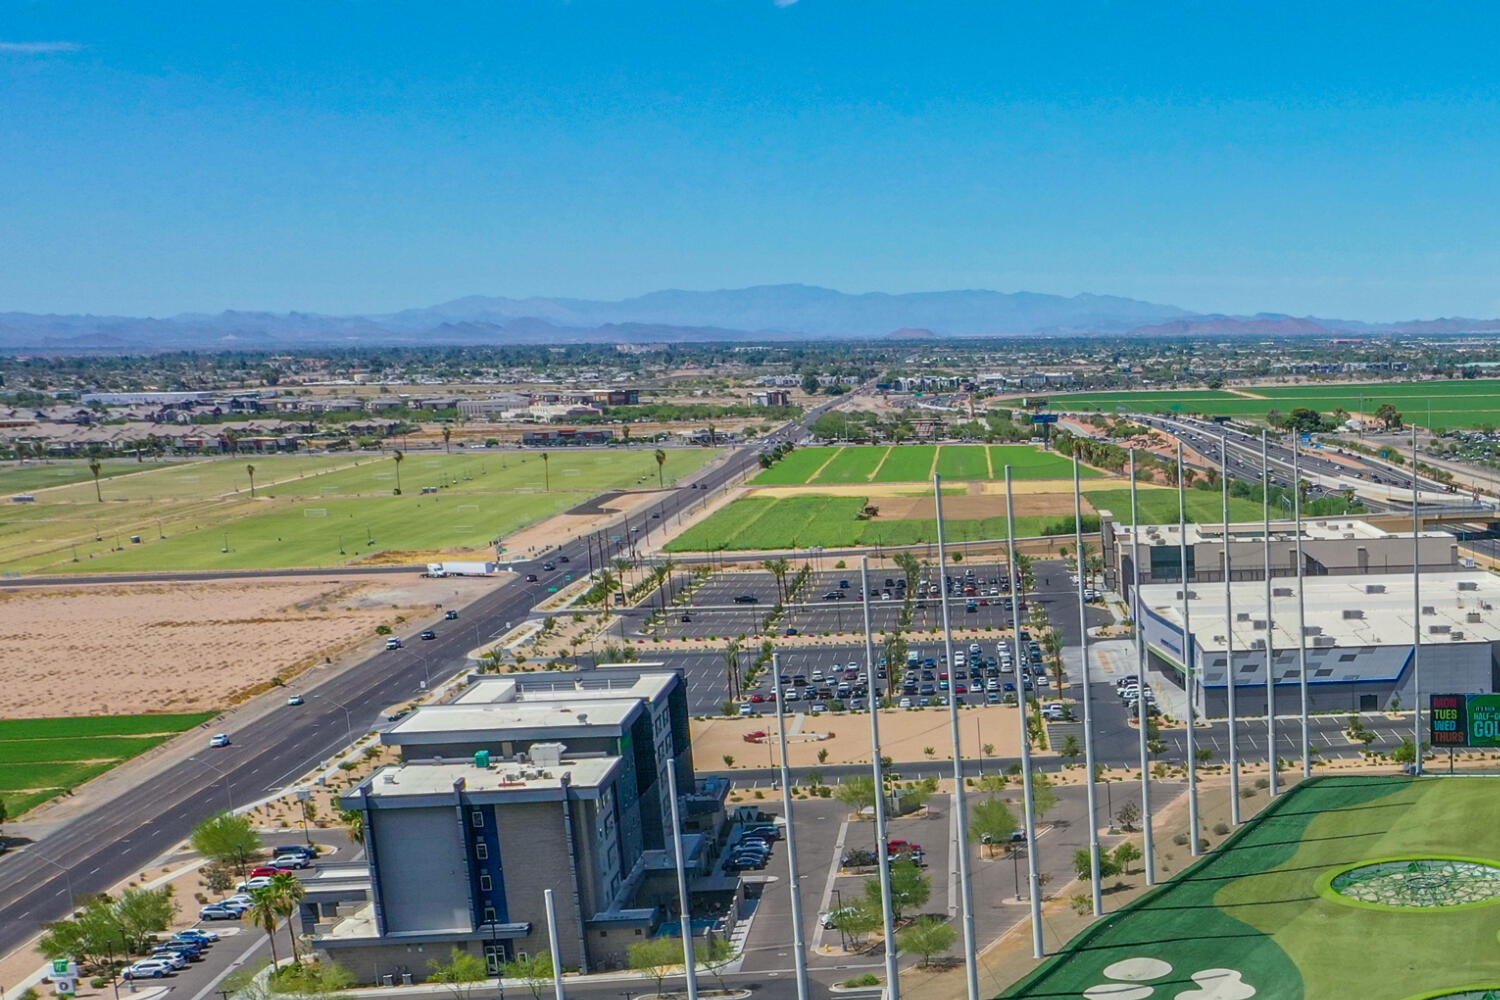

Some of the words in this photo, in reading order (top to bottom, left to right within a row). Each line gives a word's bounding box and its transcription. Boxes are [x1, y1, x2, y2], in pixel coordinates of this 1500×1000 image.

[1433, 709, 1457, 720] TUES
[1433, 720, 1456, 731] WED
[1434, 732, 1464, 742] THURS
